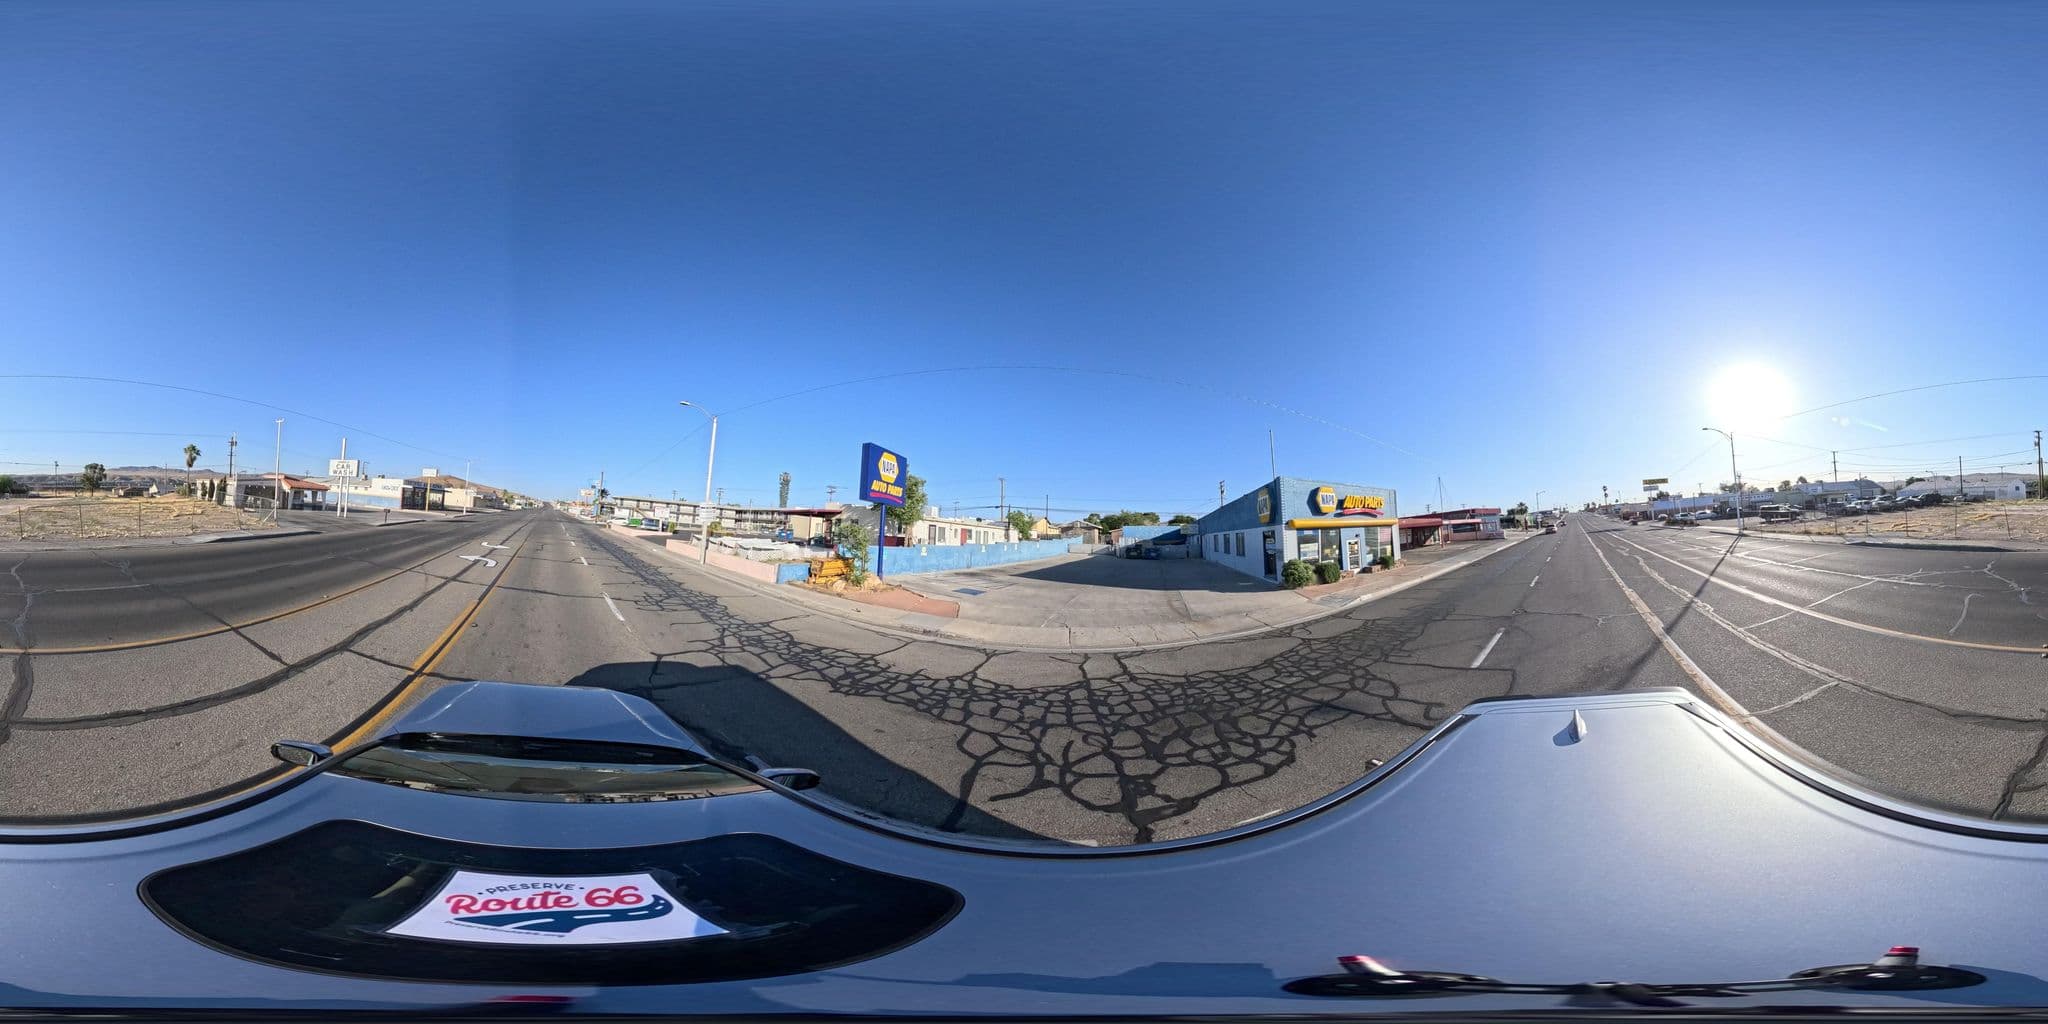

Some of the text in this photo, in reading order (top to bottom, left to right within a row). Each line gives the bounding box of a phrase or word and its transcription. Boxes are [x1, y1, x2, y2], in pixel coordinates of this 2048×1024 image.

[882, 460, 896, 474] NAPA
[871, 479, 887, 493] AUTO
[1321, 493, 1335, 506] NAPA
[1343, 495, 1385, 508] AUTO PARTS
[486, 882, 575, 895] PRESERVE
[445, 885, 645, 915] Route 66
